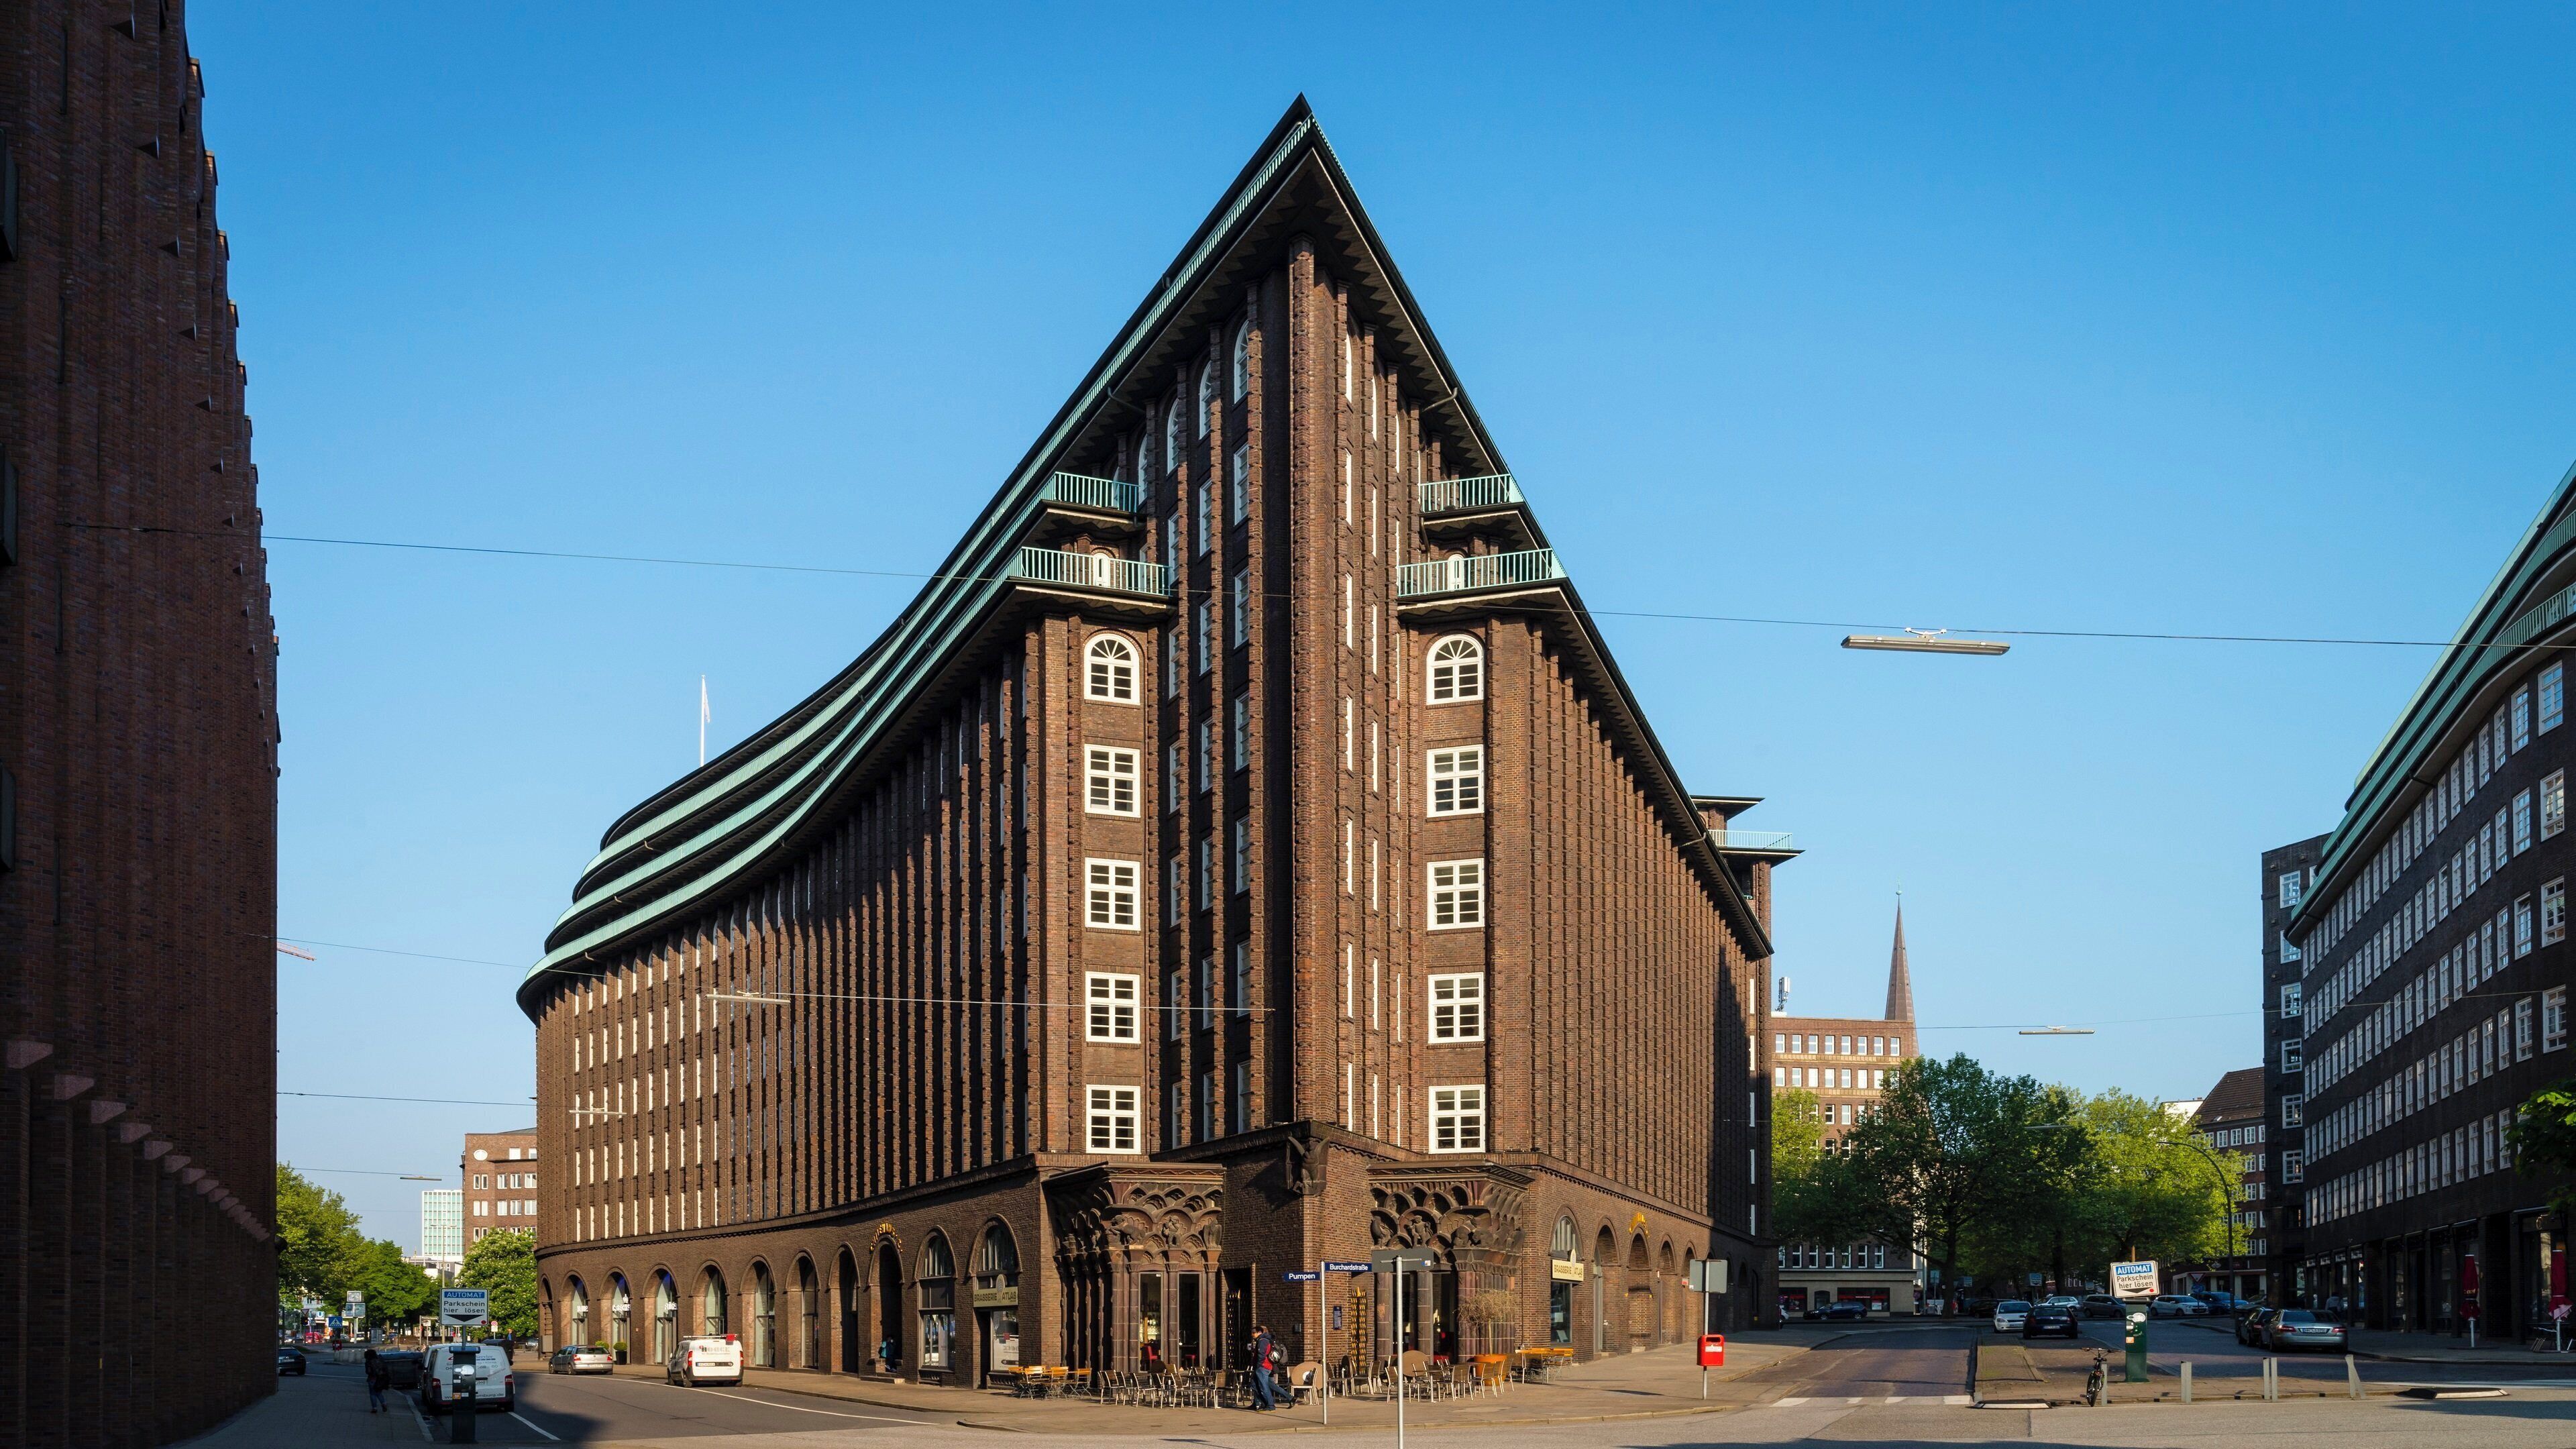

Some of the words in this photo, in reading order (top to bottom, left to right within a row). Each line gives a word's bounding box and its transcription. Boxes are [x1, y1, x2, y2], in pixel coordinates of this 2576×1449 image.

[2117, 1264, 2151, 1275] AUTOMAT
[2116, 1274, 2153, 1283] Parkschein
[974, 1293, 997, 1302] BRASSERIE
[1002, 1291, 1016, 1300] ATLAS
